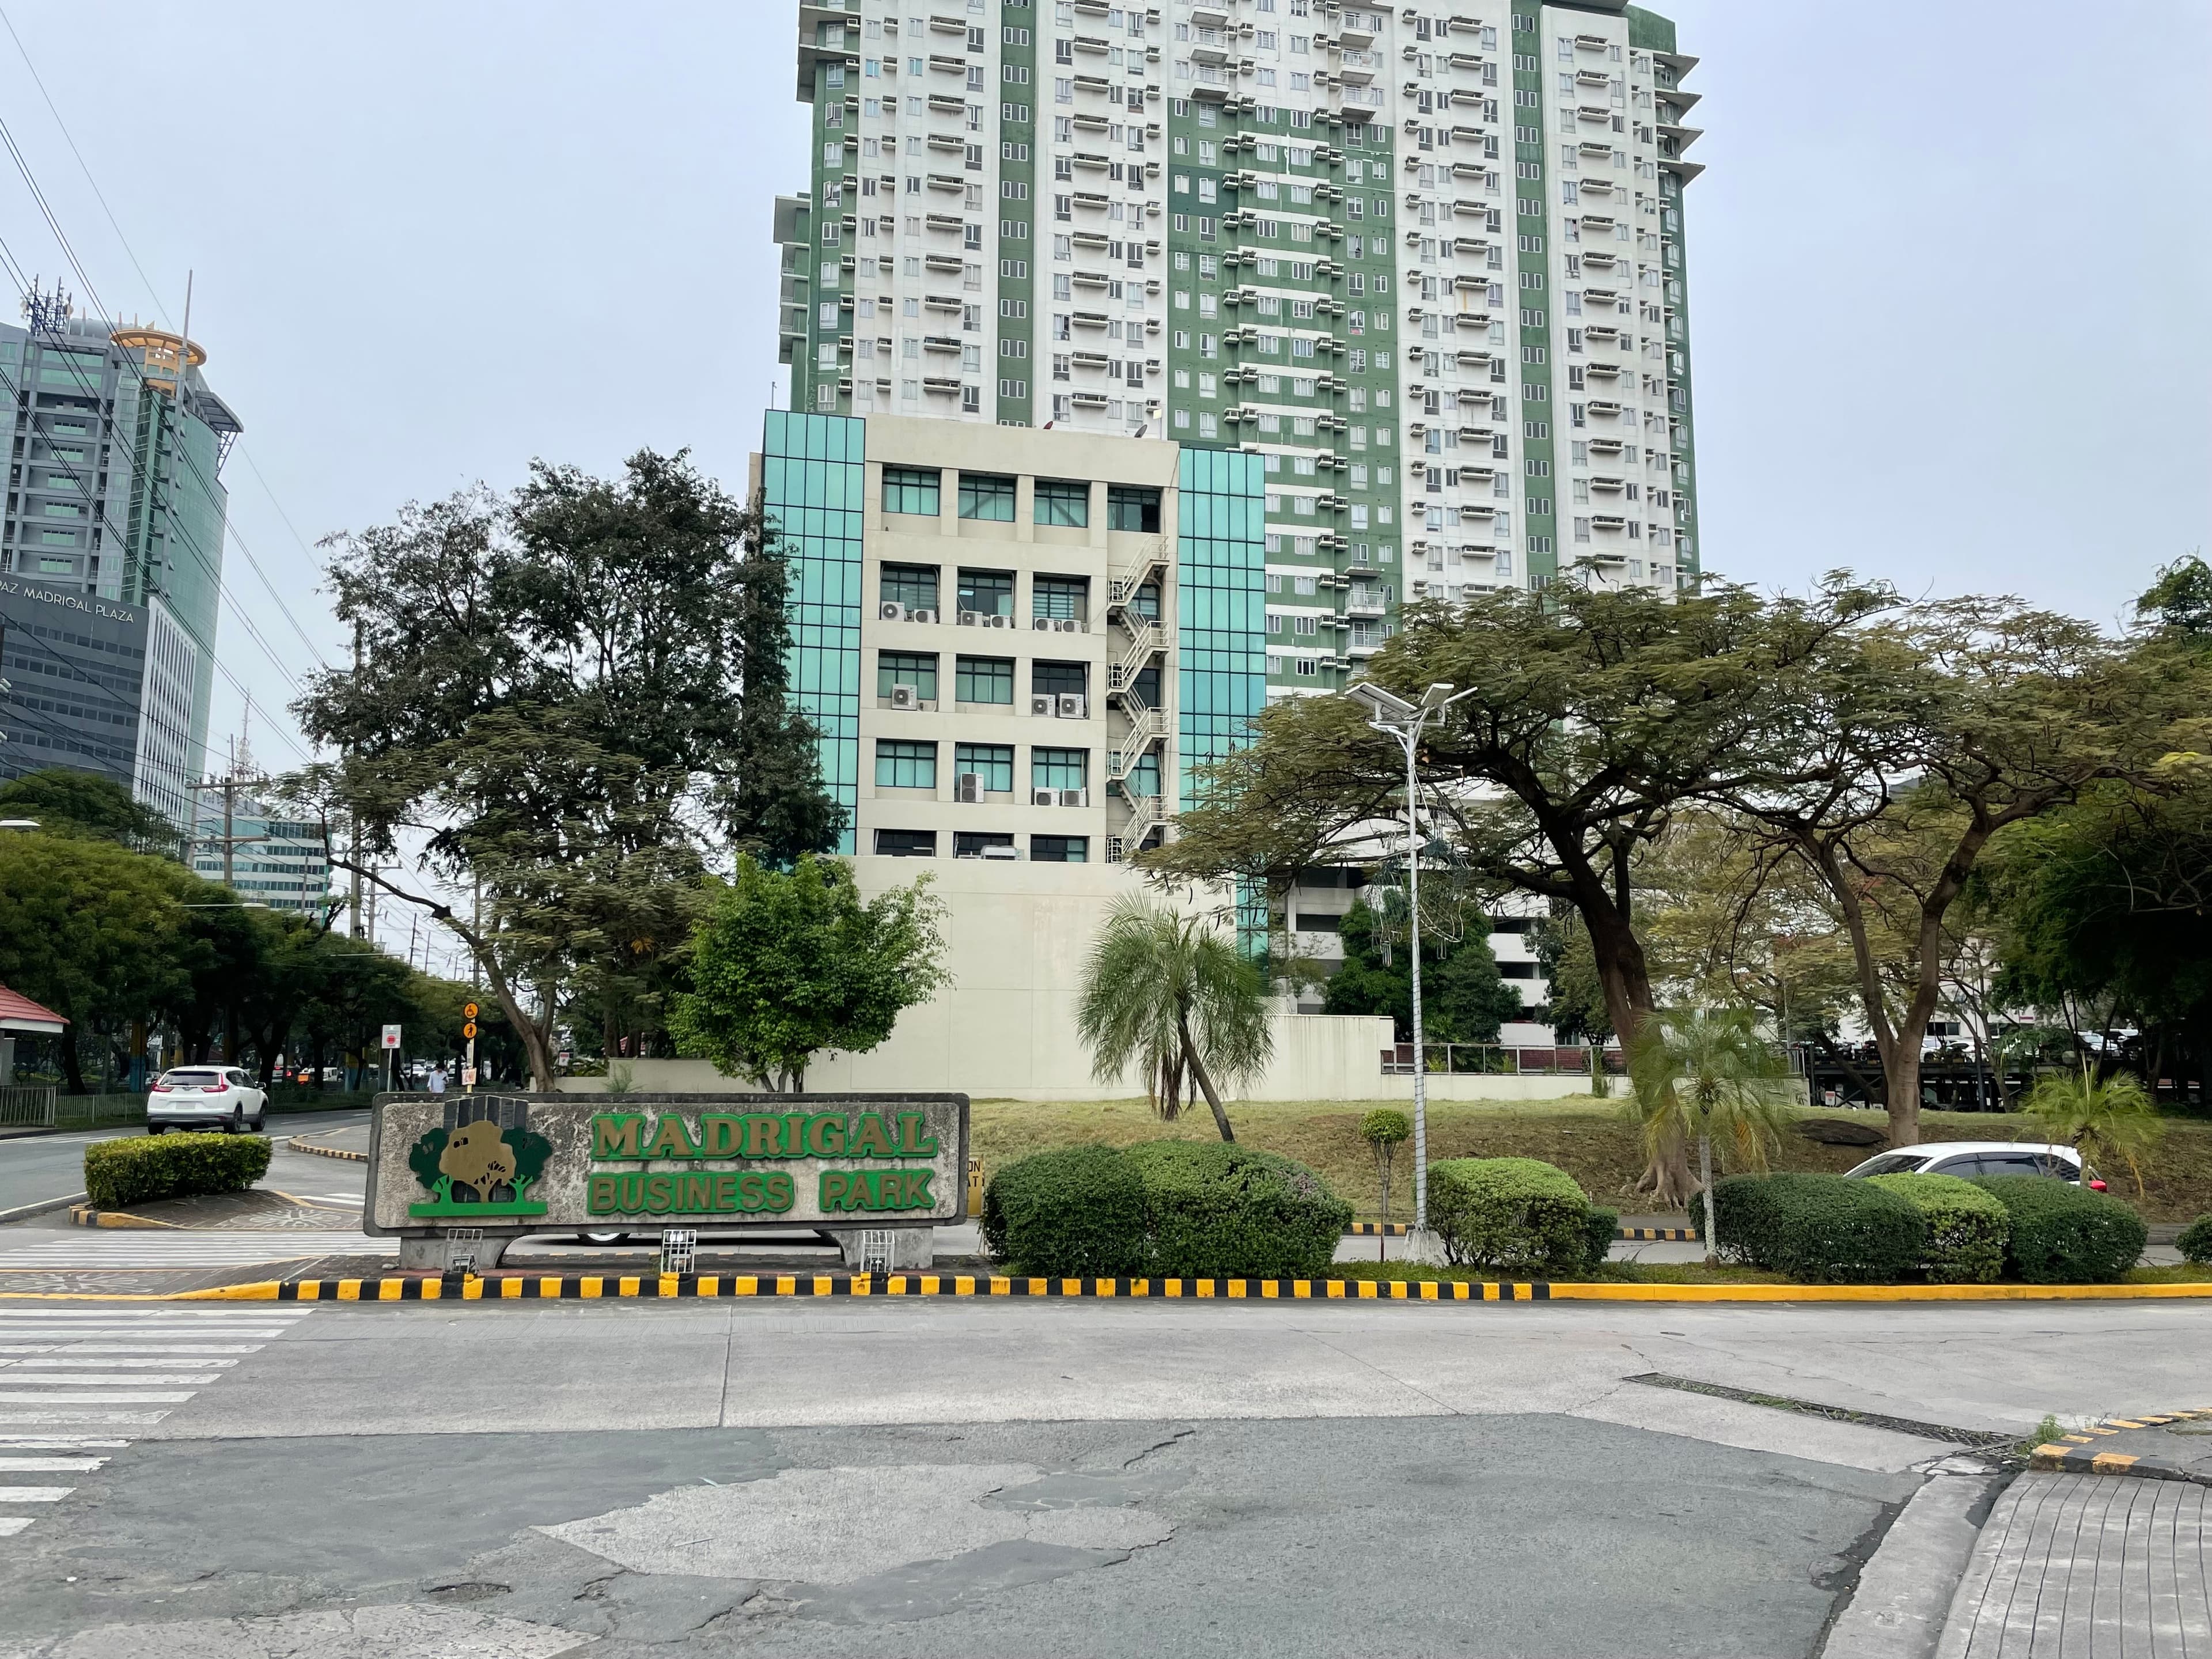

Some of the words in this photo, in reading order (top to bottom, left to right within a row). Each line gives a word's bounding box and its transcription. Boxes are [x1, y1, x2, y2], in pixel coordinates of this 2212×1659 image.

[24, 587, 91, 613] MADRIGAL
[96, 605, 134, 623] PLAZA
[593, 1116, 934, 1156] MADRIGAL
[593, 1175, 791, 1210] BUSINESS
[824, 1173, 934, 1208] PARK
